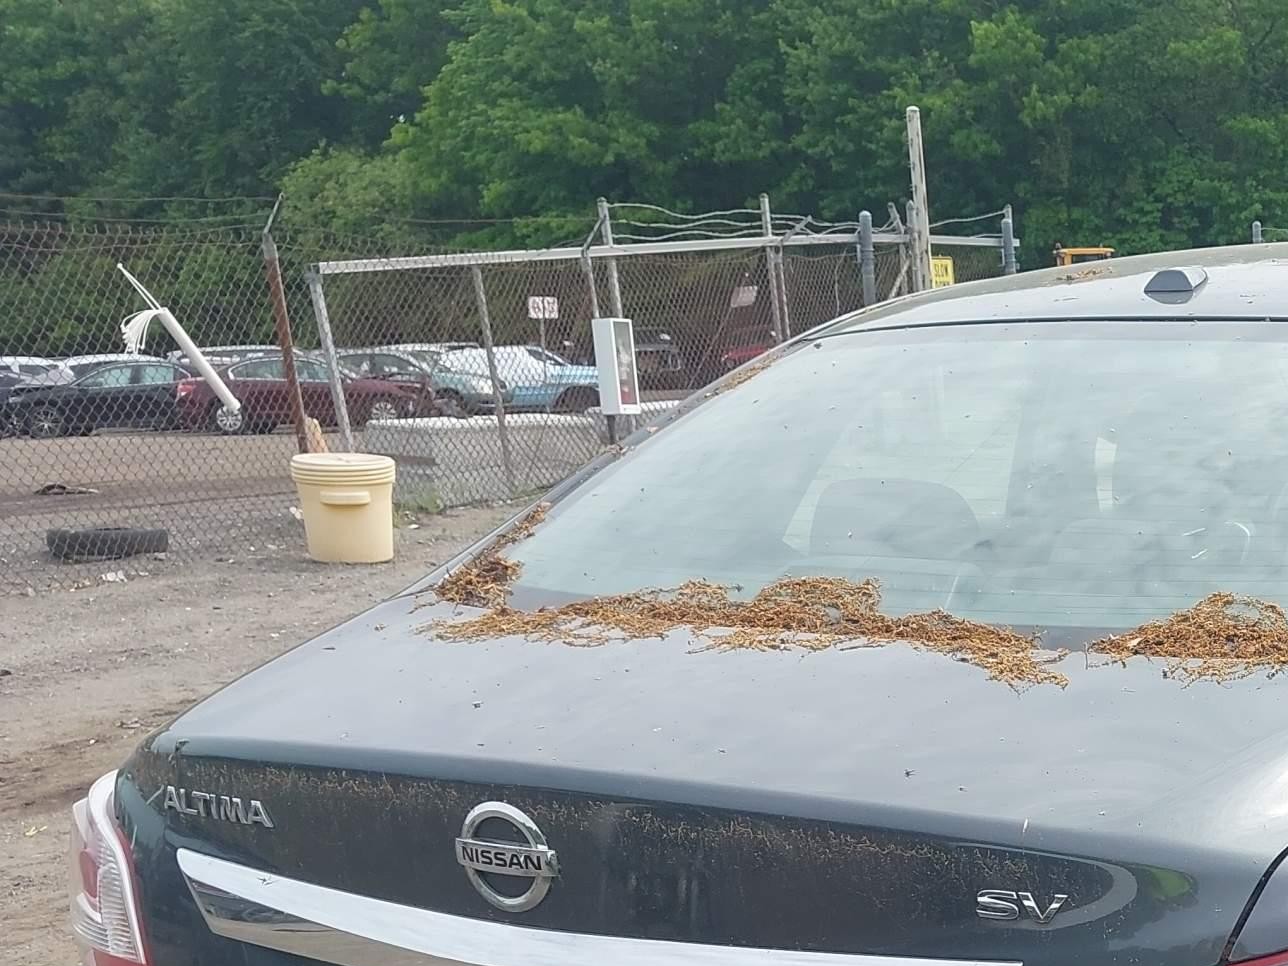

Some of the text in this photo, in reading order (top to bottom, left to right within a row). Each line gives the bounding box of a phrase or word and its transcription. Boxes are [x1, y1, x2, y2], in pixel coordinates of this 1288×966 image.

[164, 785, 274, 828] ALTIMA
[462, 846, 543, 871] NISSAN
[976, 889, 1068, 924] SV
